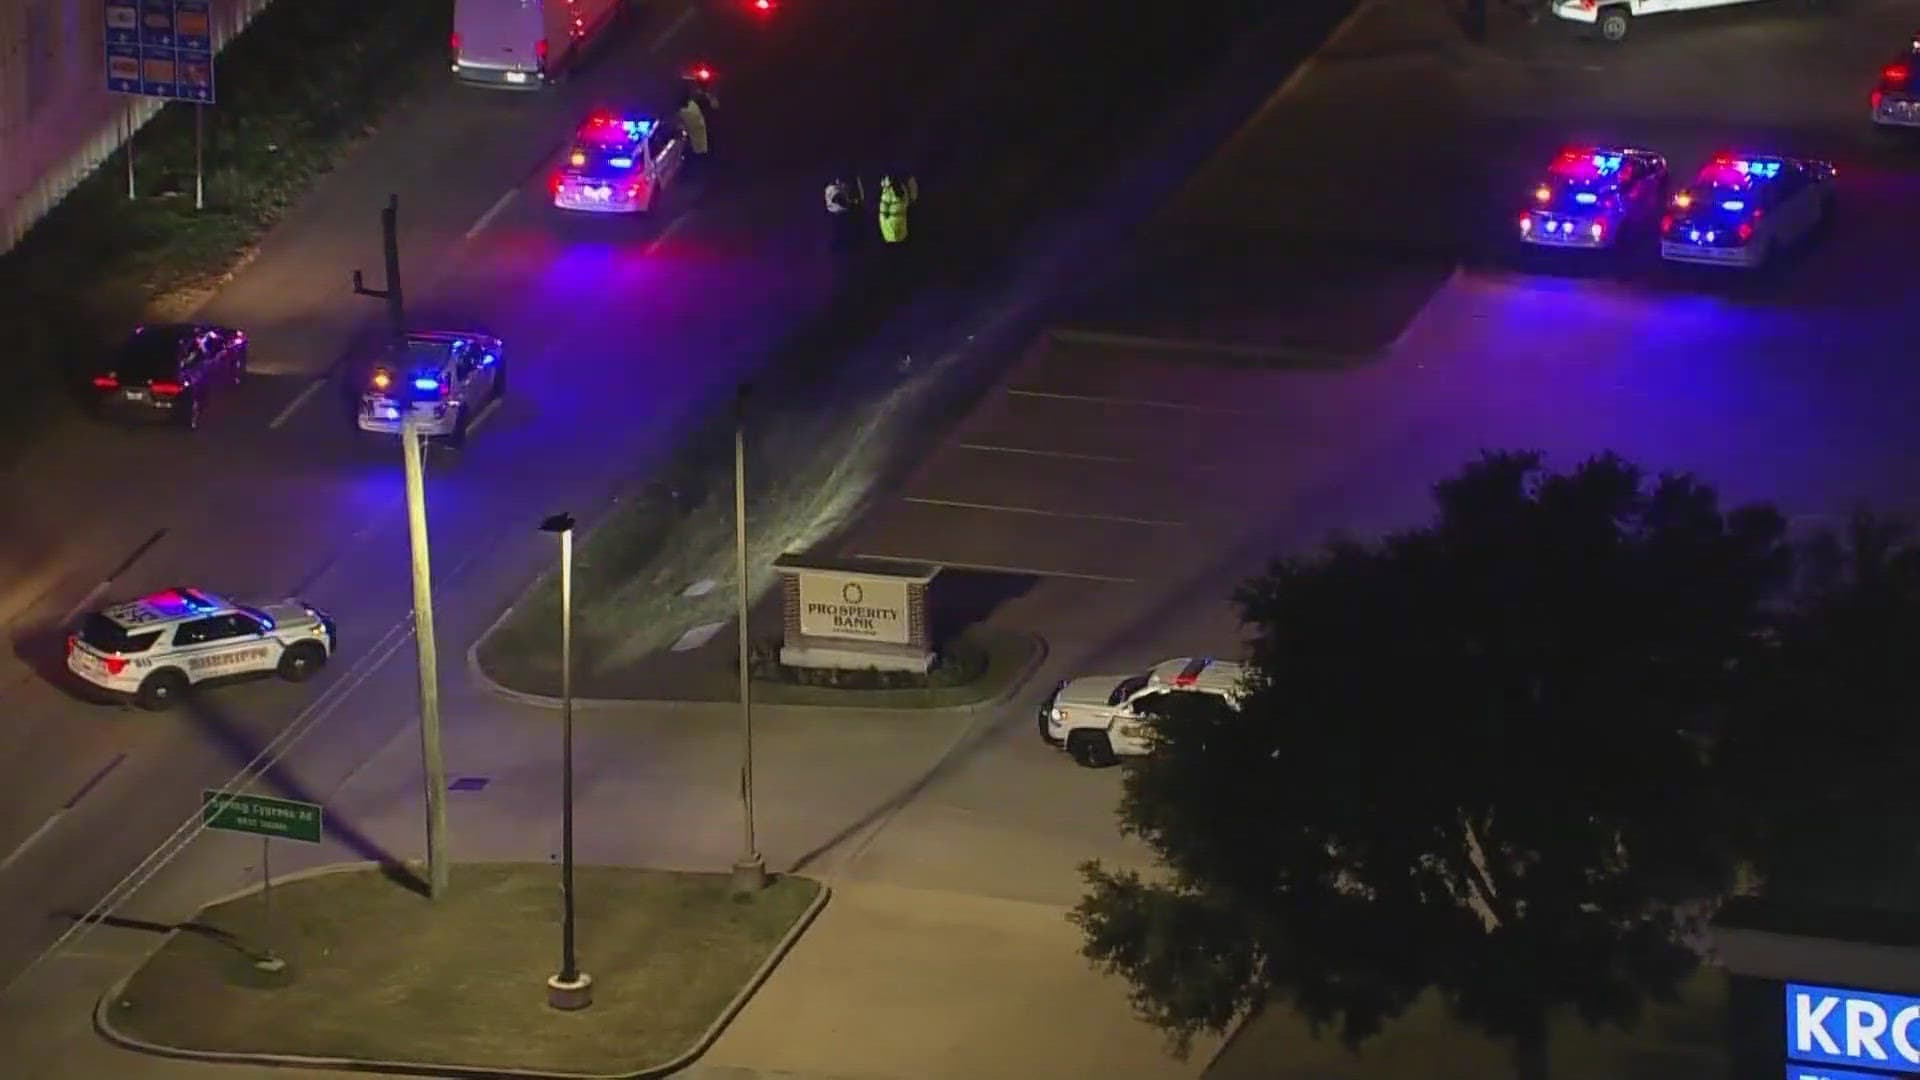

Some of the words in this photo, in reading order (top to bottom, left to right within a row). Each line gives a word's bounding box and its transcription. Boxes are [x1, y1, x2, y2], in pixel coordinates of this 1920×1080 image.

[808, 603, 897, 621] PROSPERITY
[833, 615, 874, 630] BANK
[252, 803, 296, 819] Cypress
